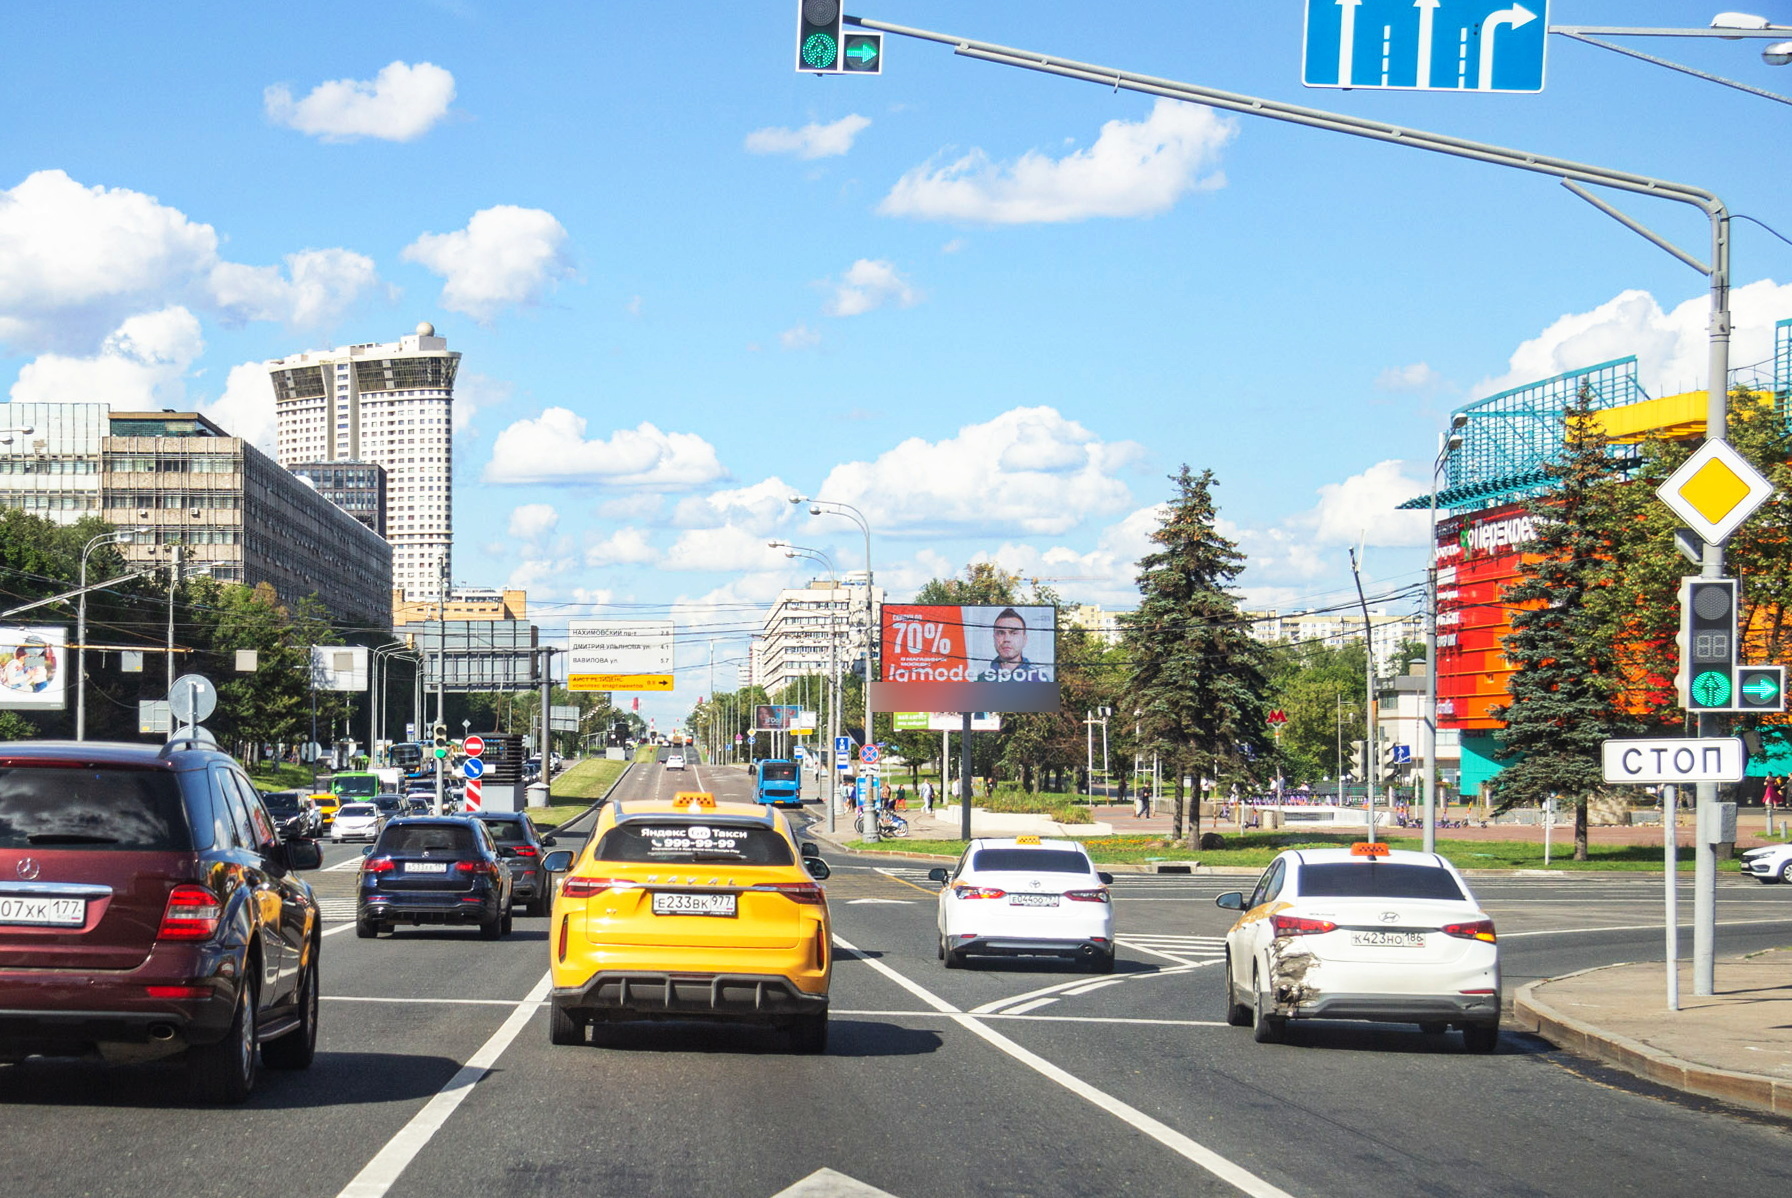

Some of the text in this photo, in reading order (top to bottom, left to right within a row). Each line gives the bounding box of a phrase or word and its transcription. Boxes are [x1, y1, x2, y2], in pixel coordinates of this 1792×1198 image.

[572, 628, 622, 636] НАХИМОВСКИЙ
[892, 623, 951, 655] 70%
[984, 665, 1048, 682] sport
[1622, 747, 1721, 775] СТОП
[641, 828, 686, 838] Яндекс
[712, 829, 747, 839] Такси
[664, 838, 736, 848] 999-99-99
[647, 875, 737, 886] HAVAL
[53, 900, 79, 914] 177
[658, 895, 731, 909] Е233ВК 977
[1354, 932, 1422, 945] К423НО 186
